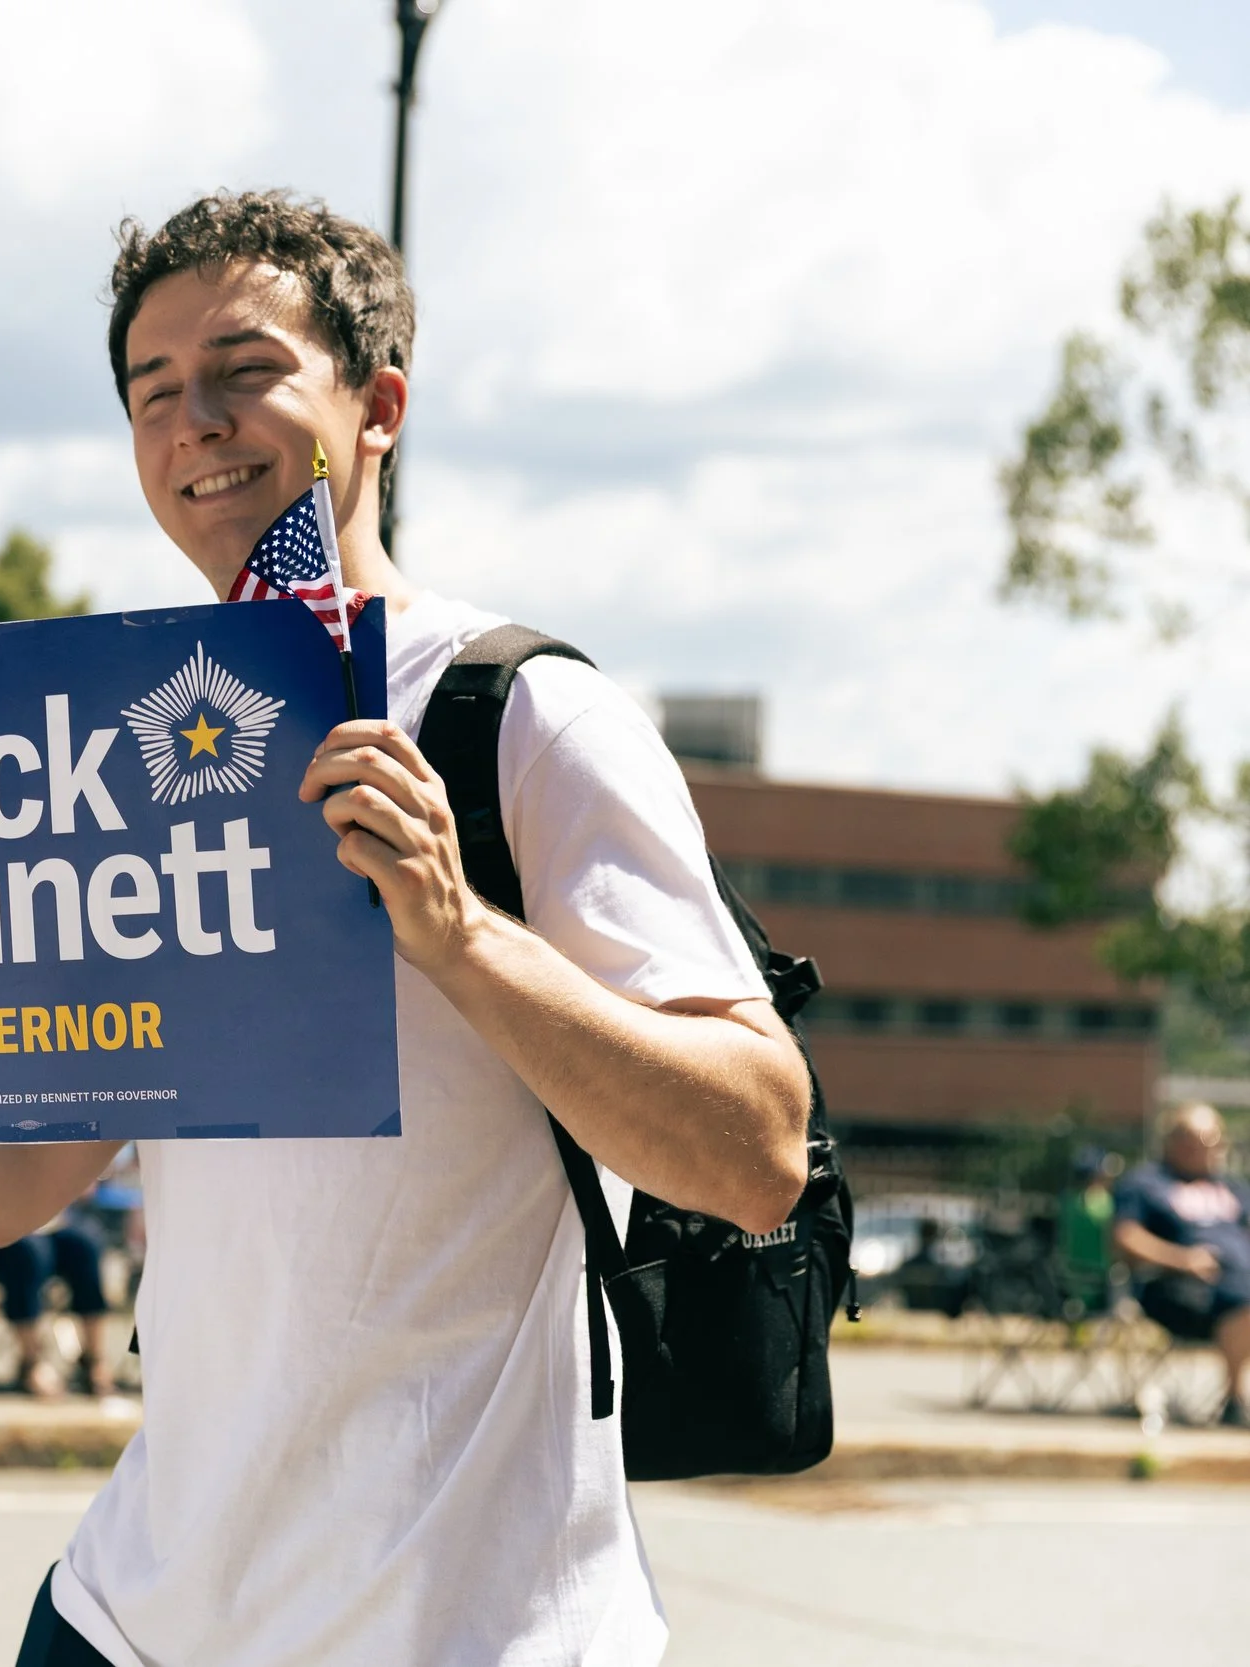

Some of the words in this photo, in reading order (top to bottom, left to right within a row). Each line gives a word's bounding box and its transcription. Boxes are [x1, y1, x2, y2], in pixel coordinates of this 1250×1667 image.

[24, 1093, 39, 1104] BY
[40, 1091, 90, 1104] BENNETT
[92, 1090, 115, 1102] FOR
[116, 1089, 179, 1101] GOVERNOR
[741, 1220, 798, 1249] OAKLEY
